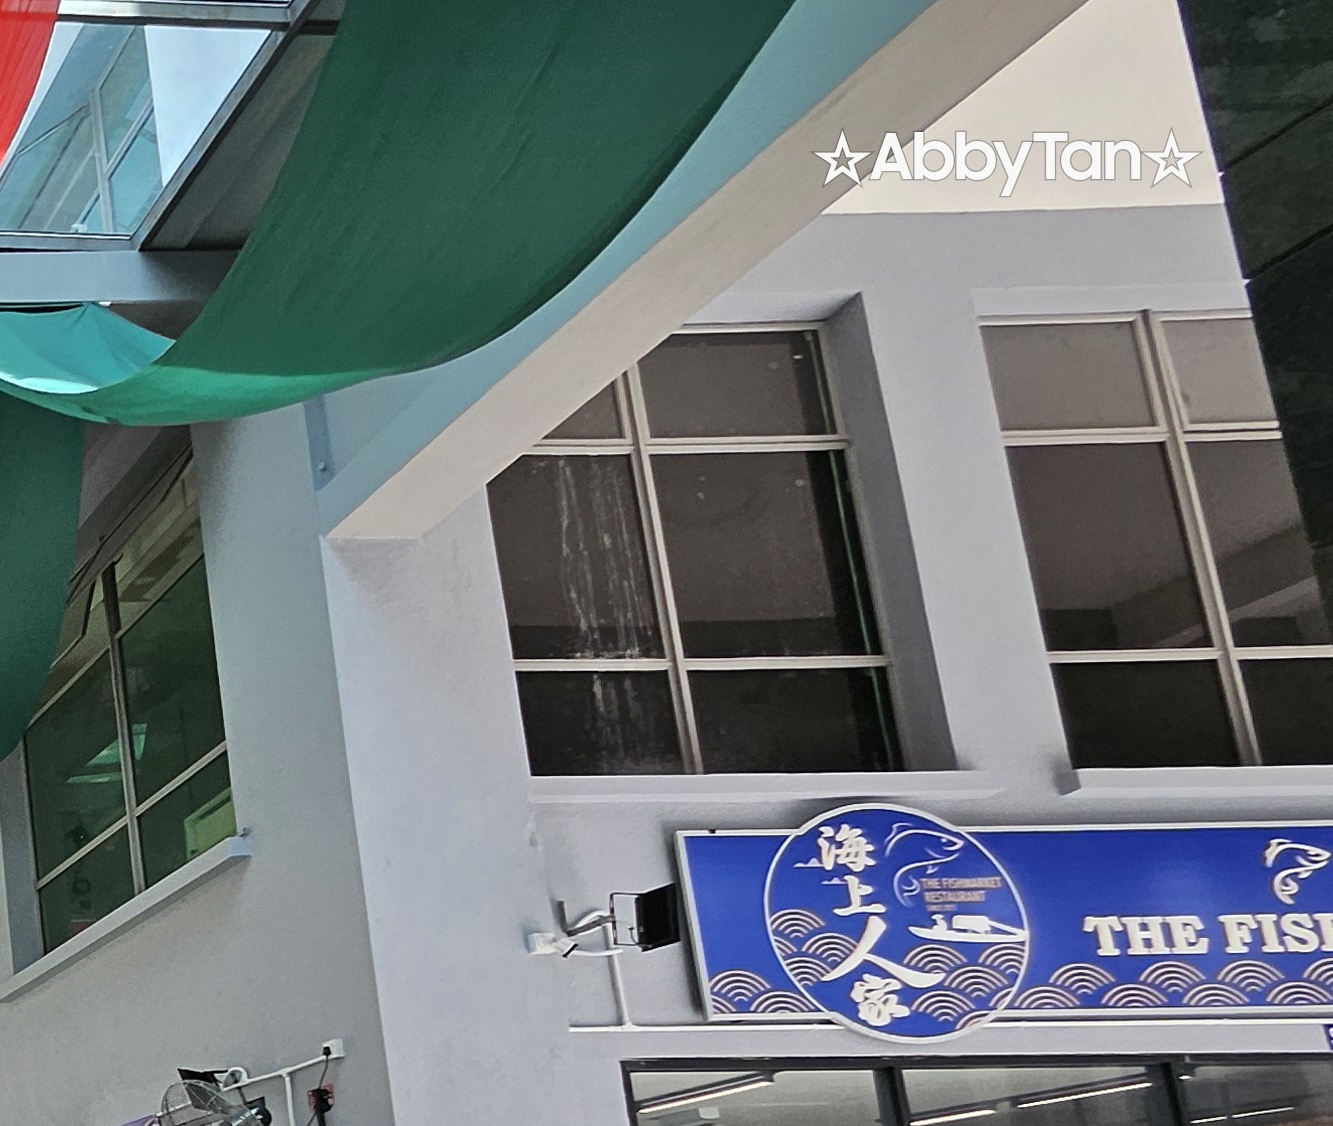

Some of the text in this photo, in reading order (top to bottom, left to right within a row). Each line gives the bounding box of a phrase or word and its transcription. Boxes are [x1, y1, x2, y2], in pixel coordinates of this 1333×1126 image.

[920, 878, 941, 889] THE
[817, 824, 947, 1027] 海上人家
[1083, 915, 1210, 957] THE
